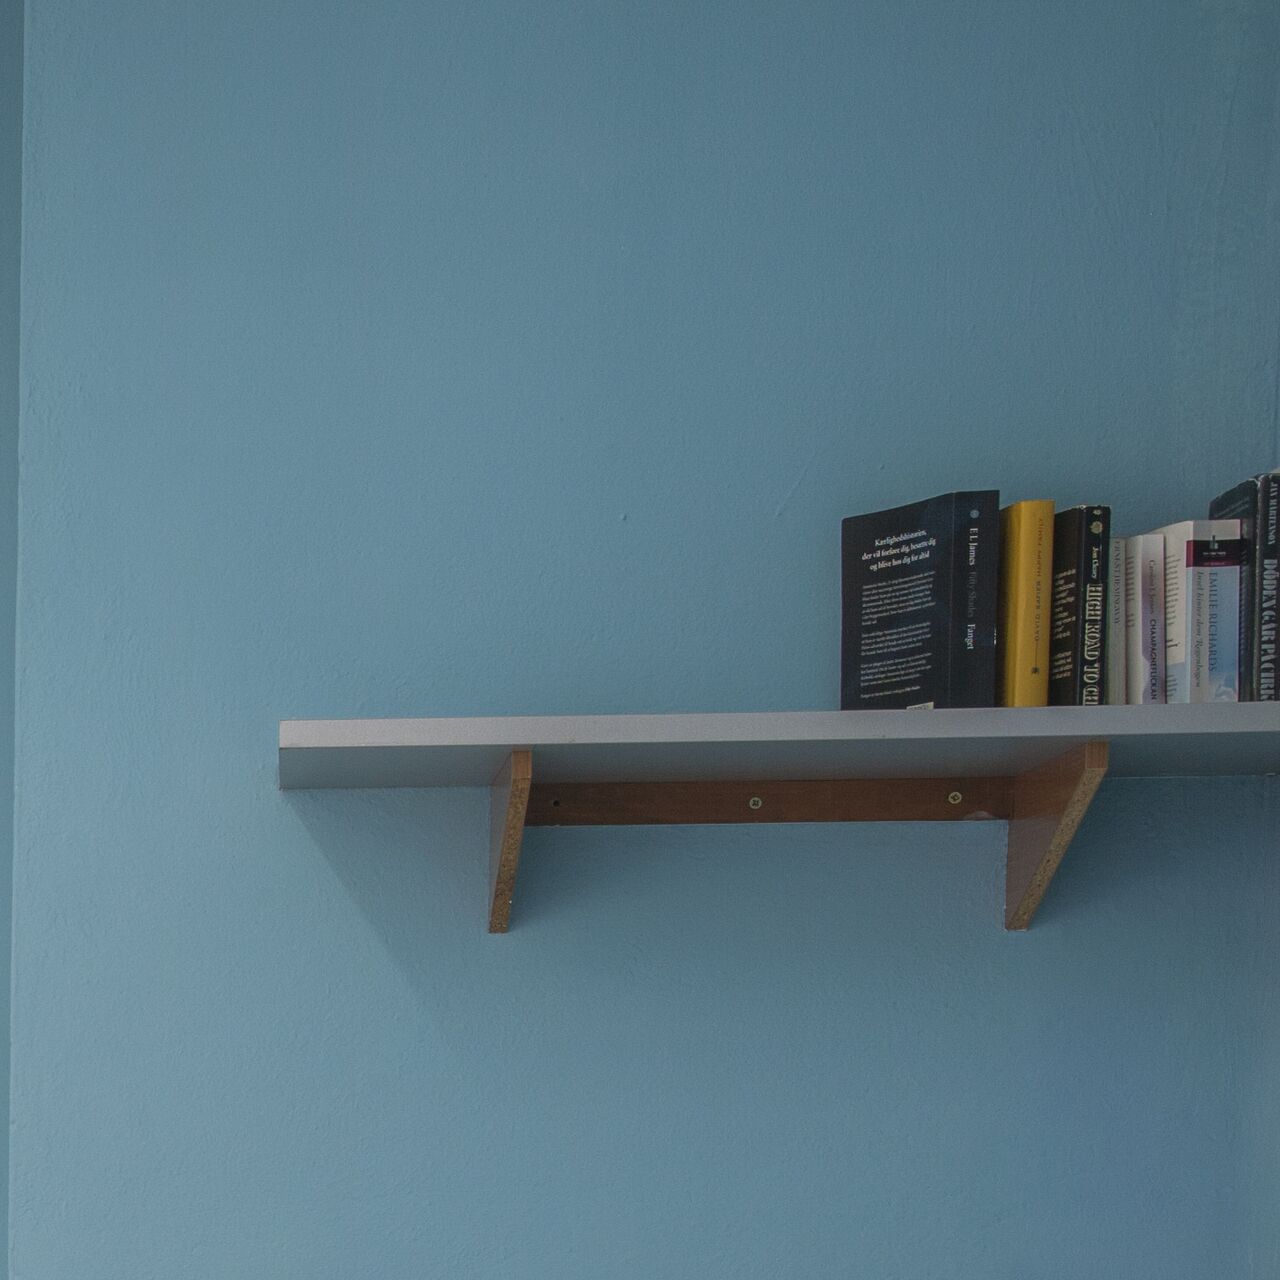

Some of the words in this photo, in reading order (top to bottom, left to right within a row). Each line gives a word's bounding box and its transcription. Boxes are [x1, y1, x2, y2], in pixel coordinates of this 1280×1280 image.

[968, 542, 978, 566] James
[1086, 583, 1103, 620] HIGH
[1209, 572, 1218, 609] EMILIE
[964, 623, 976, 650] Fanget
[1084, 621, 1102, 660] ROAD
[1208, 613, 1217, 672] RICHARDS
[1083, 663, 1100, 683] TO
[1149, 619, 1157, 700] CHAMPAGNEFLICKAN
